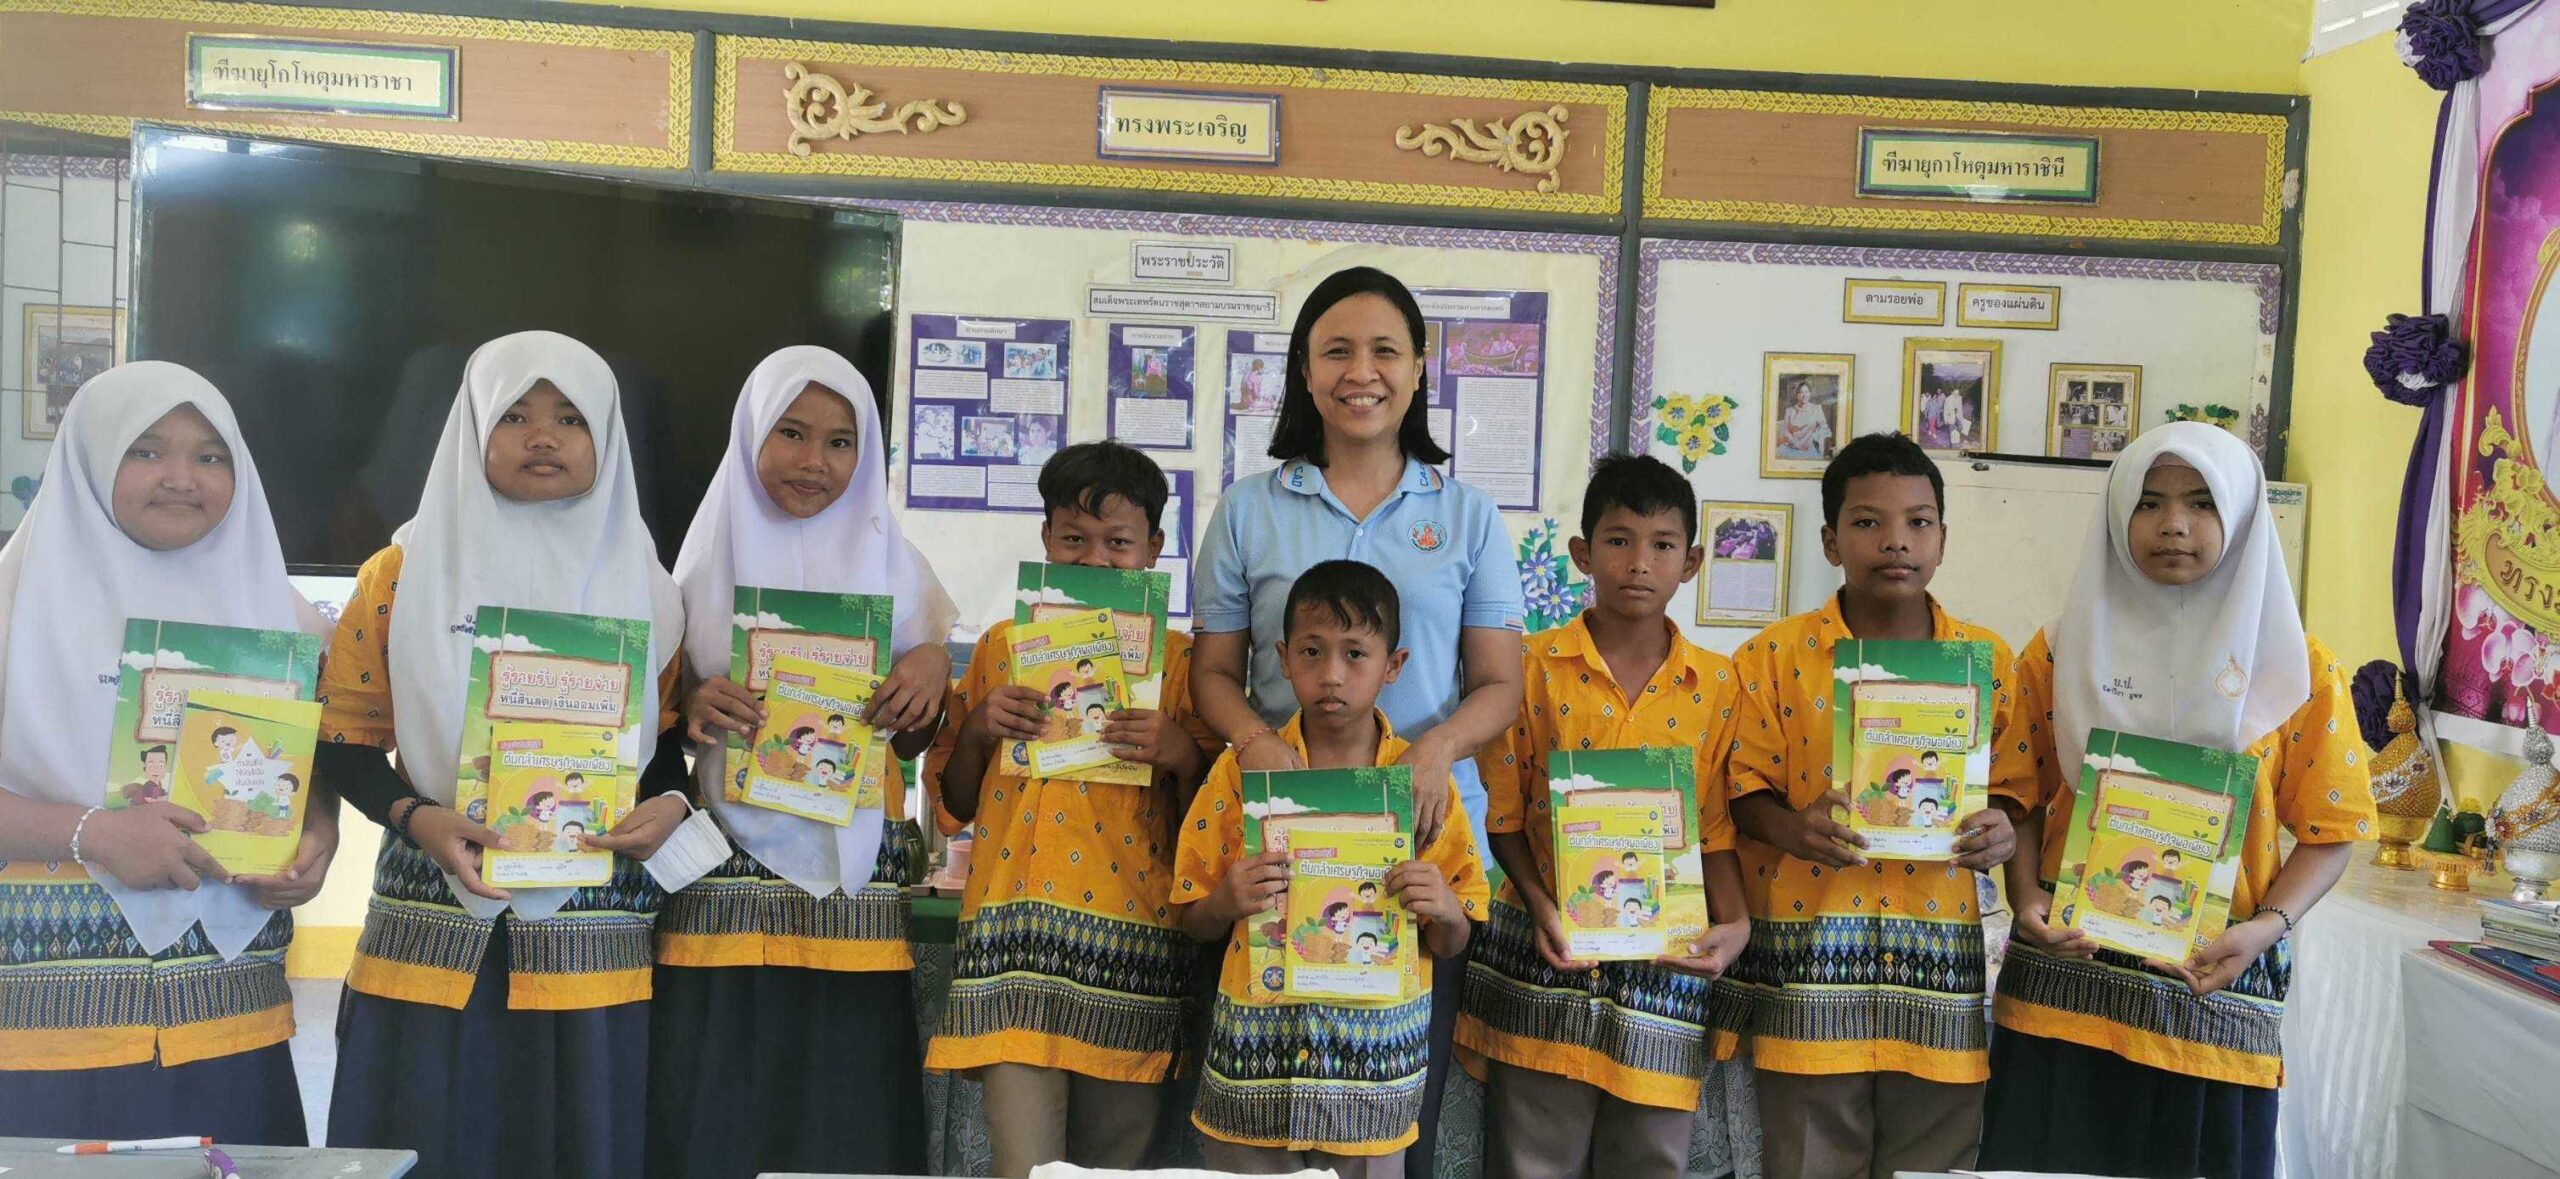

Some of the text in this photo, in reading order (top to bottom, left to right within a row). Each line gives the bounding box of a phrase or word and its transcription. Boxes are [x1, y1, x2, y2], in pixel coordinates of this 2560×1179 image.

[1116, 114, 1247, 144] ทรงพระเจริญ
[1141, 253, 1225, 269] พระราชประวัติ
[1865, 293, 1924, 305] ตามรอยพ่อ
[1972, 296, 2045, 311] ครูของแผ่นดิน
[2500, 560, 2560, 614] ทรง
[502, 664, 619, 694] รู้รายรับ รู้รายจ่าย
[500, 688, 616, 712] หนี้สินลด เงินออมเพิ่ม
